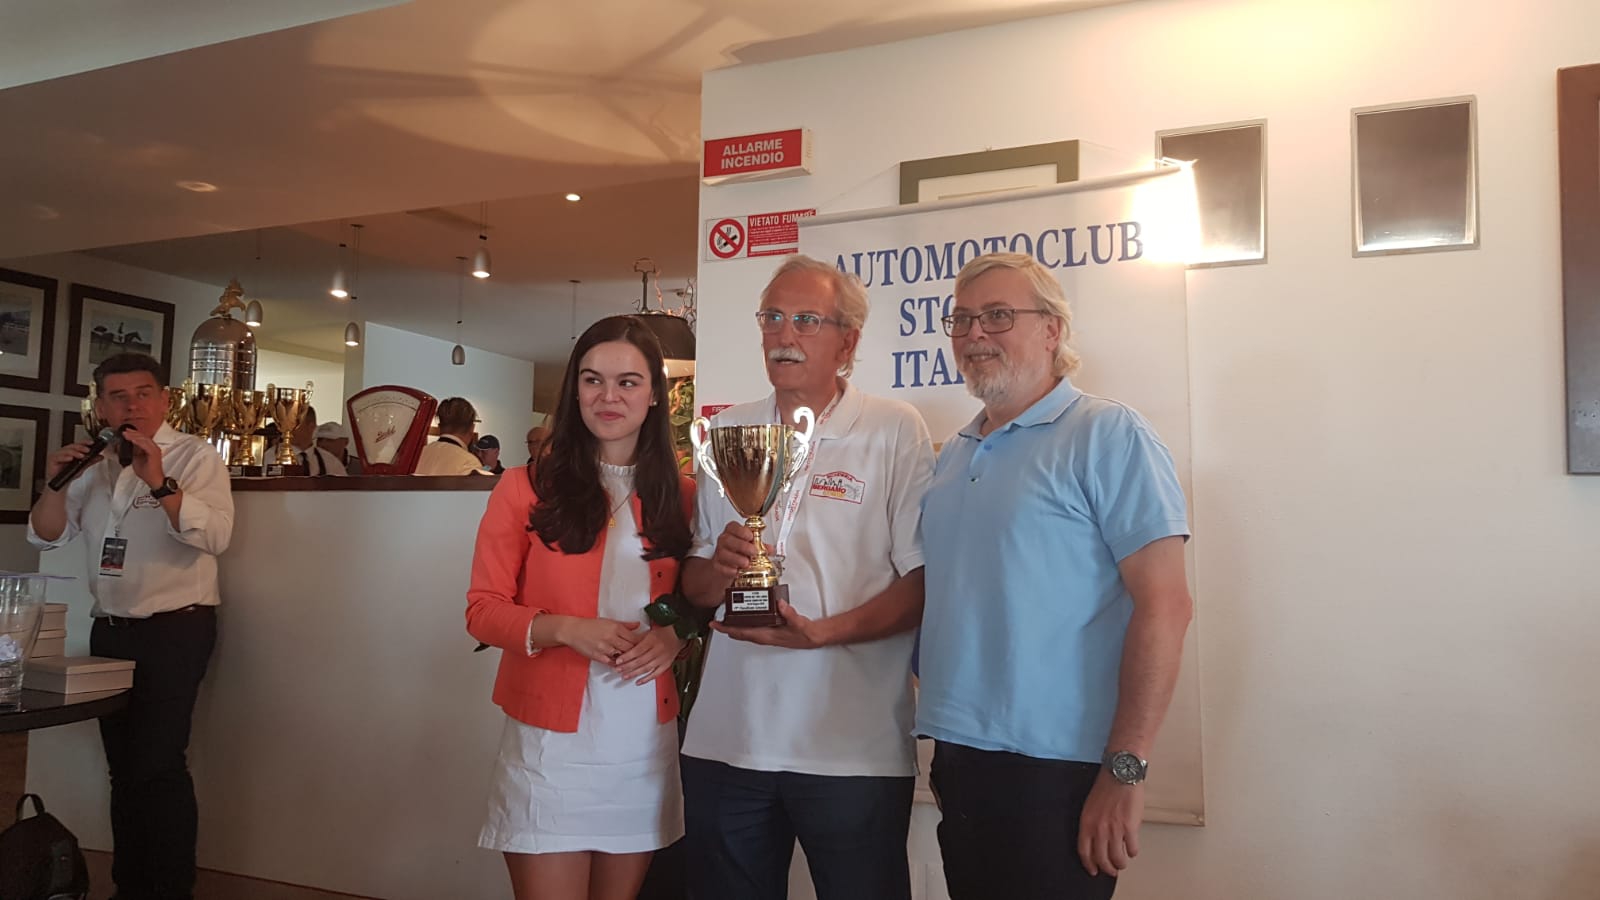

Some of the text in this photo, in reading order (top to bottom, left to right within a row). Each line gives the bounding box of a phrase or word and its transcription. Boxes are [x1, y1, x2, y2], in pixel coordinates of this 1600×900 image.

[722, 138, 783, 157] ALLARME
[721, 151, 785, 170] INCENDIO
[749, 215, 779, 228] VIETATO
[891, 347, 965, 389] ITA
